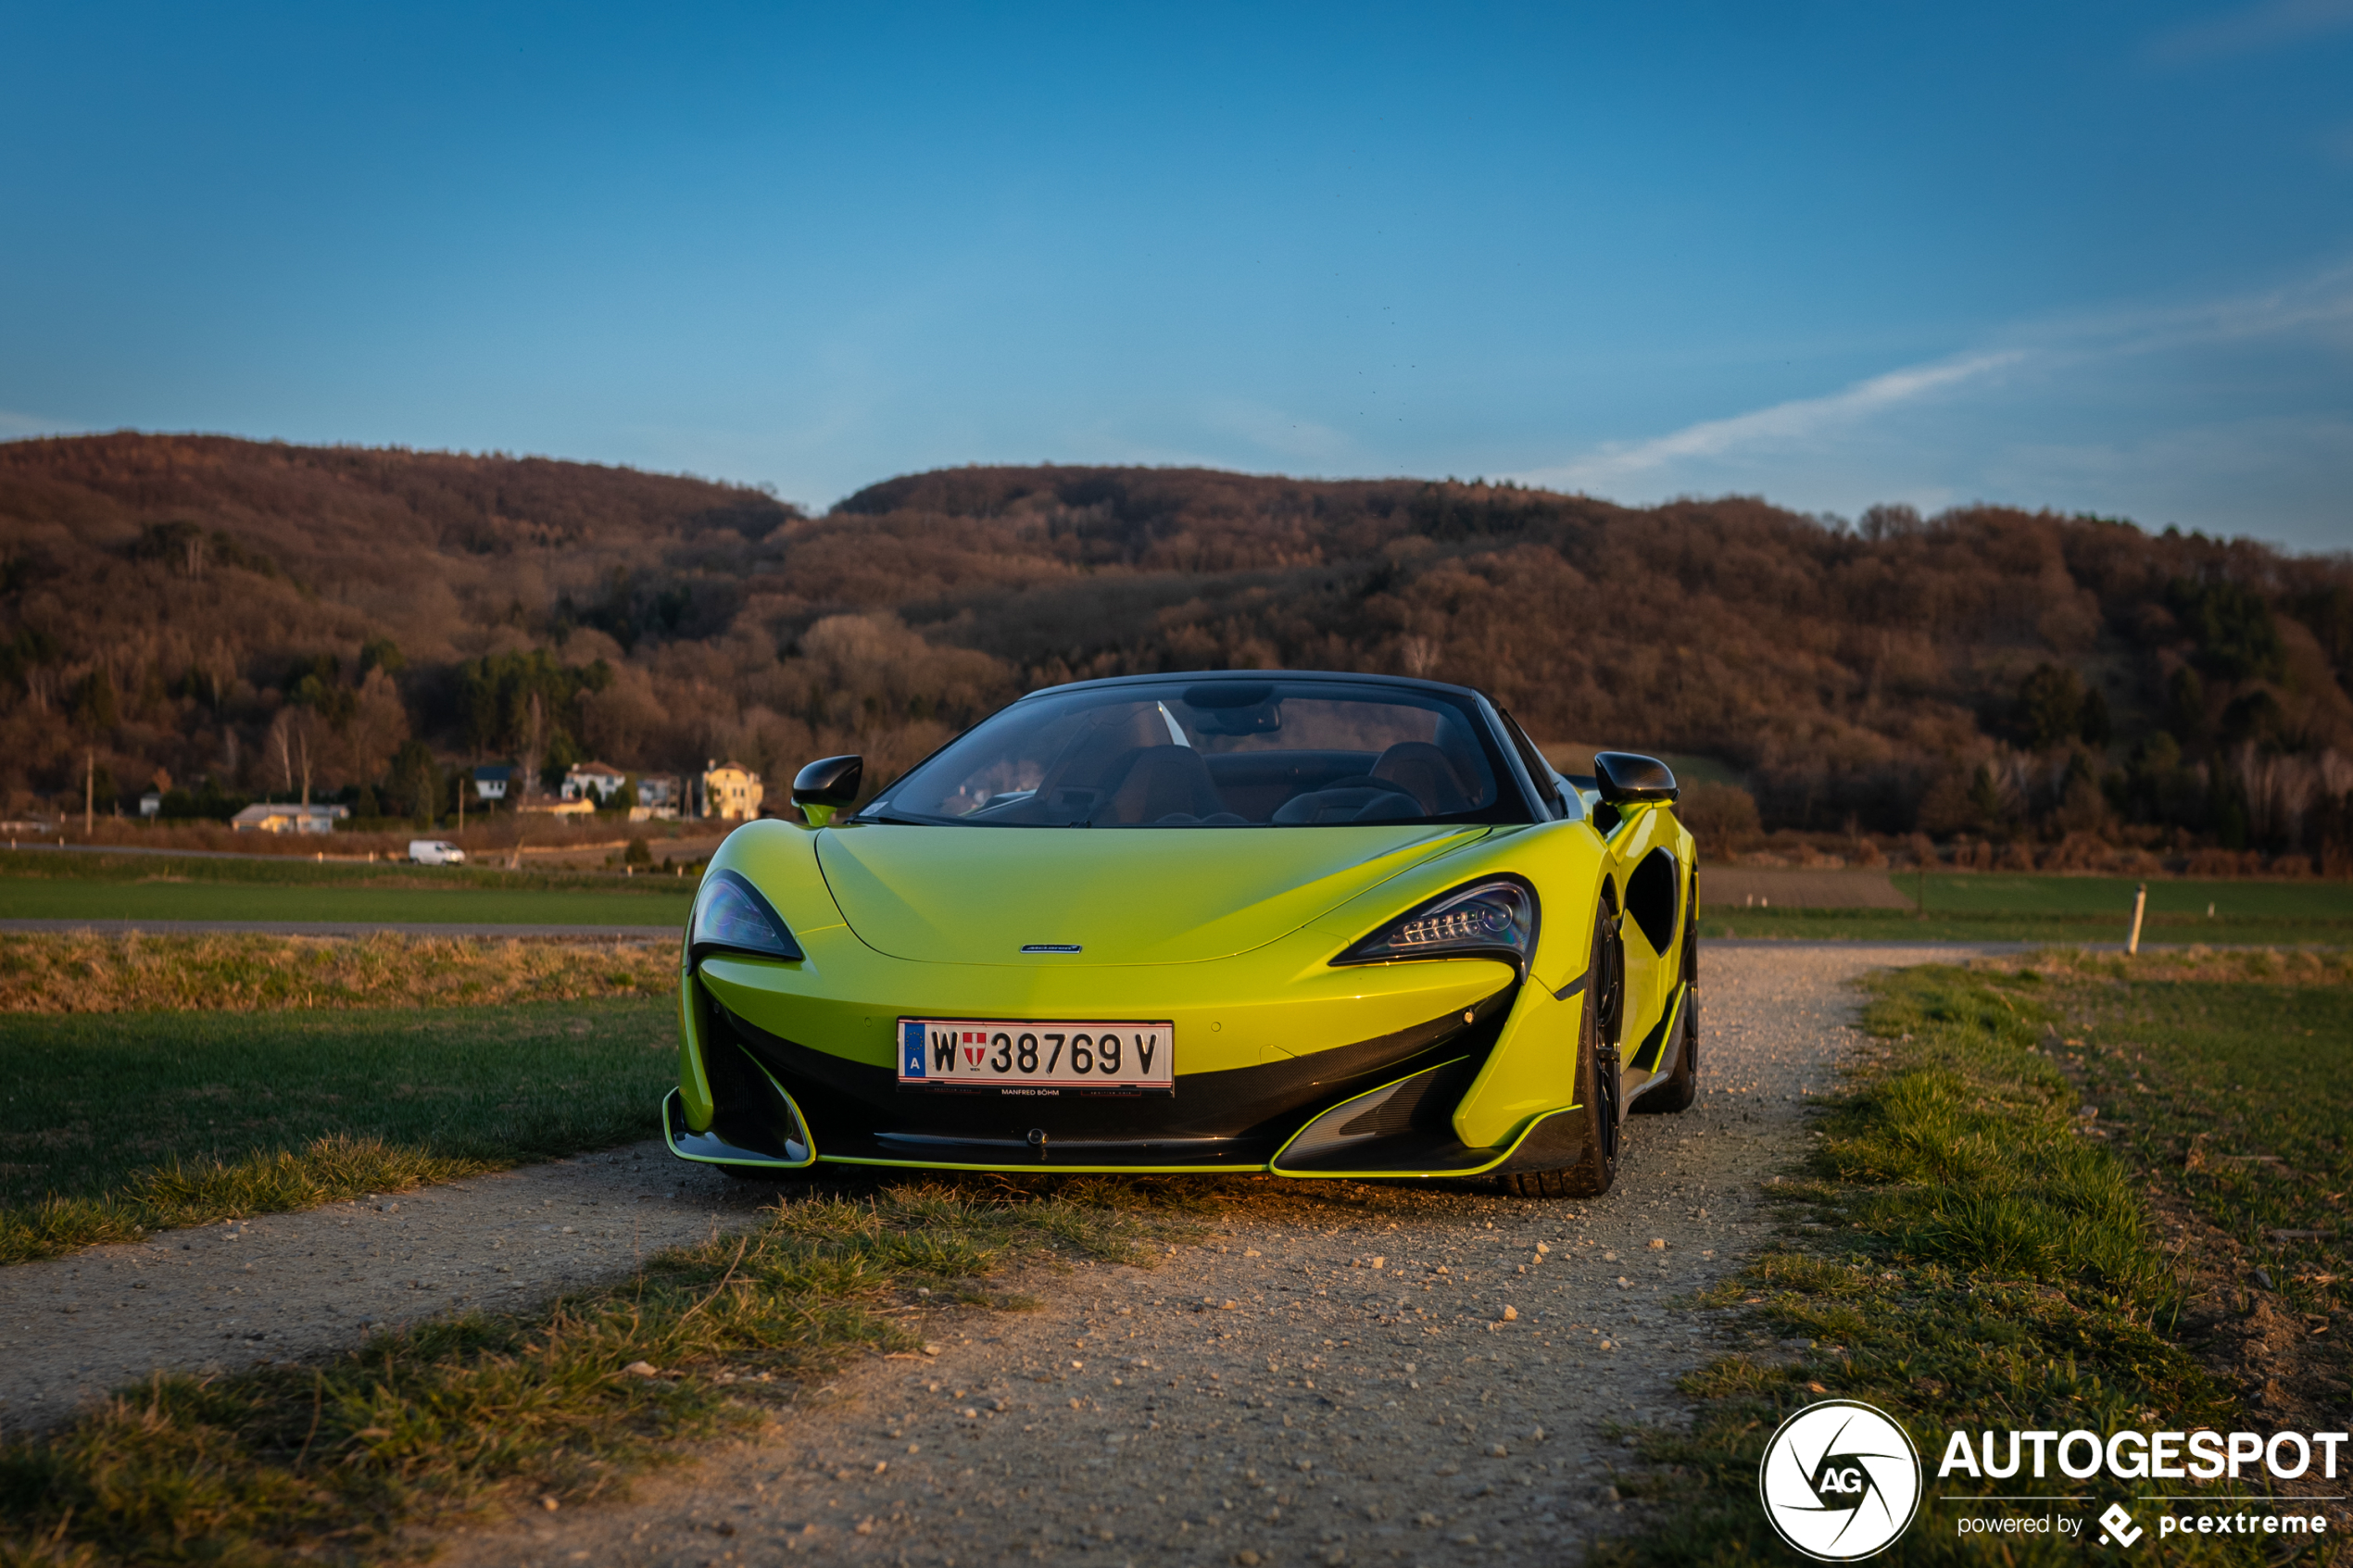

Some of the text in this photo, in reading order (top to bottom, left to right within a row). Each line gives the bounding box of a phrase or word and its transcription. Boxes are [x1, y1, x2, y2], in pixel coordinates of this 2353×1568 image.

[932, 1031, 1158, 1075] W 38769 V
[910, 1058, 920, 1070] A
[1037, 1087, 1059, 1096] BÖHM
